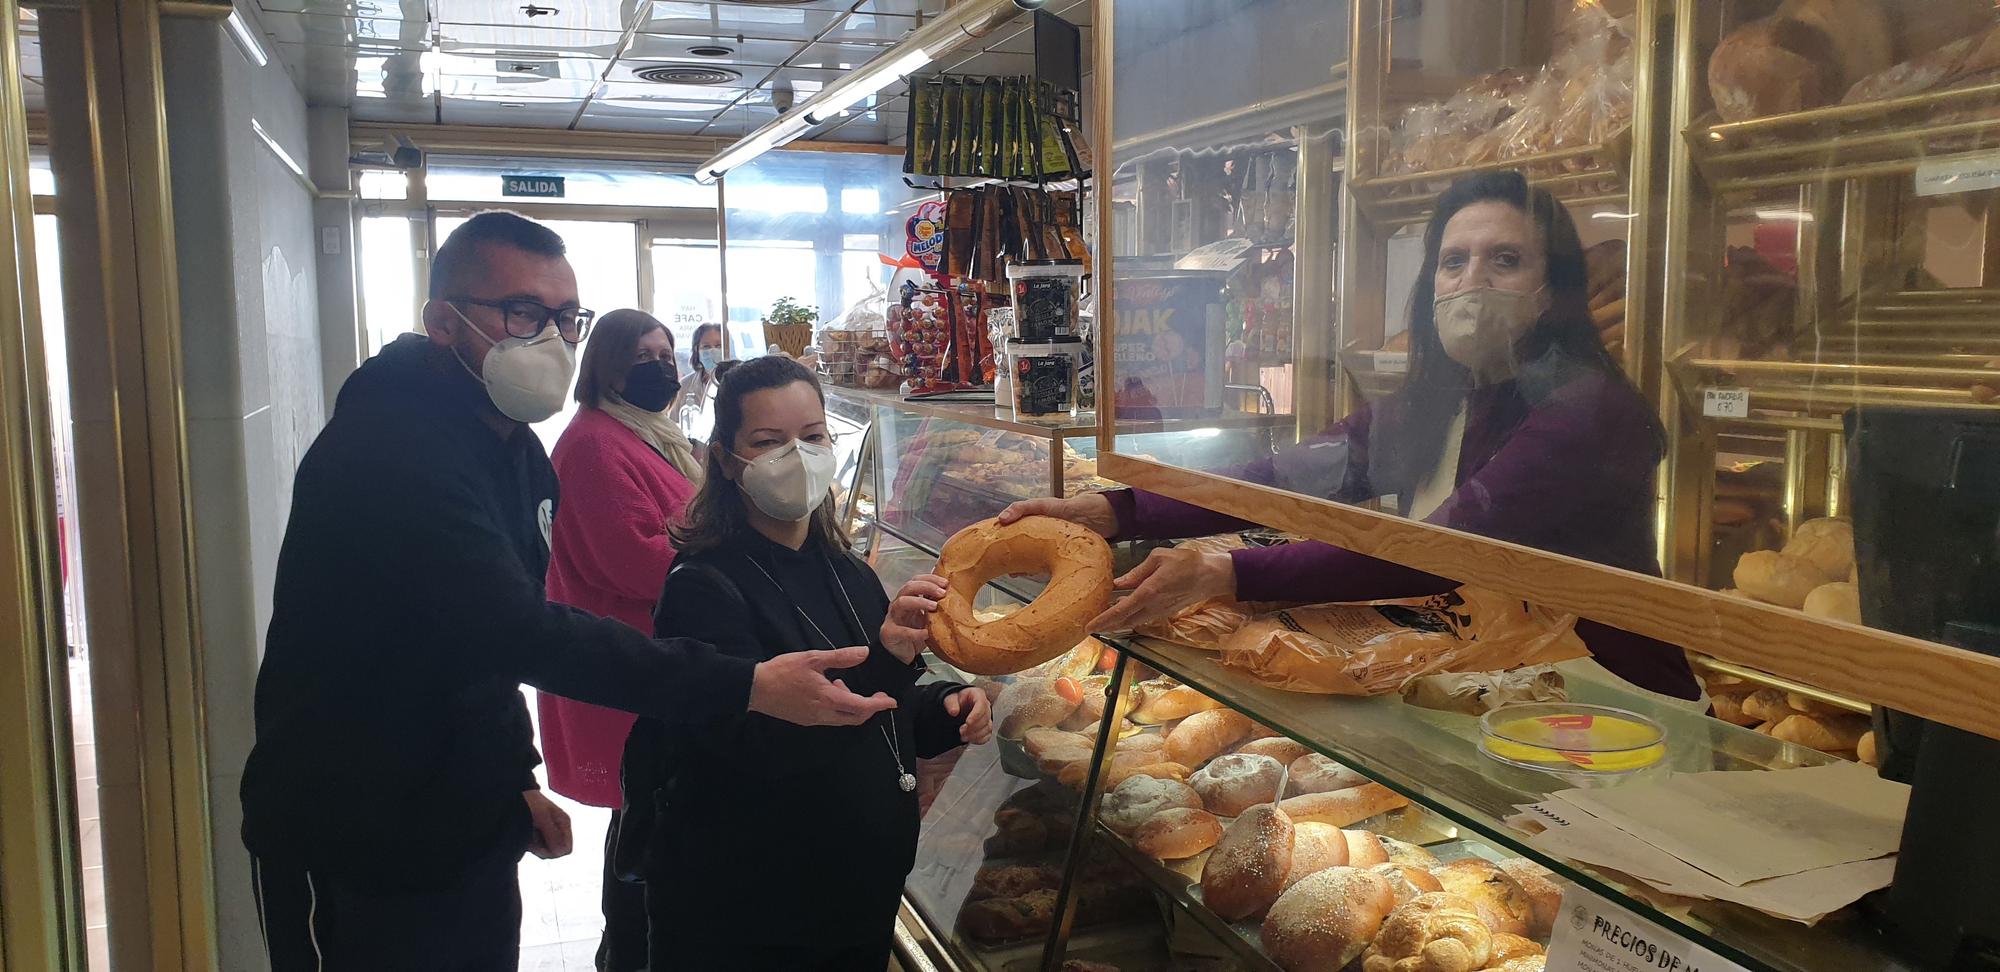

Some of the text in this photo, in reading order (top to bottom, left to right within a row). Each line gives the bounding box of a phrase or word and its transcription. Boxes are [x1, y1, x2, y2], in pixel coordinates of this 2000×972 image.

[509, 180, 558, 193] SALIDA
[913, 234, 943, 252] MELOD
[1593, 915, 1658, 963] PRECIOS
